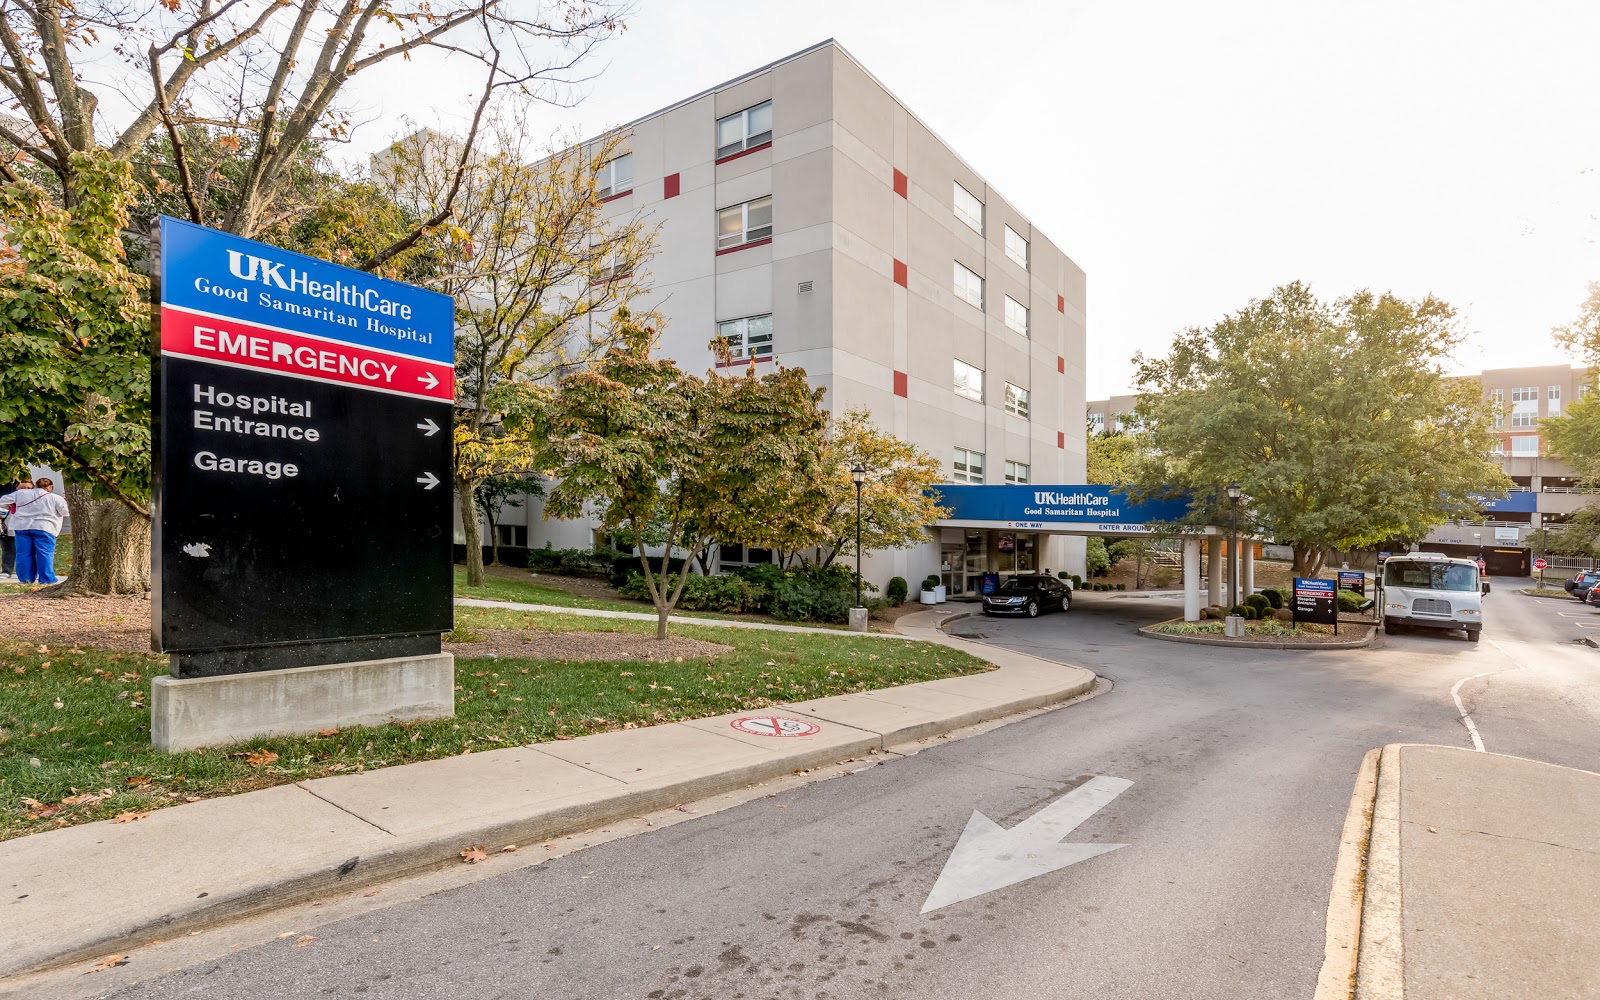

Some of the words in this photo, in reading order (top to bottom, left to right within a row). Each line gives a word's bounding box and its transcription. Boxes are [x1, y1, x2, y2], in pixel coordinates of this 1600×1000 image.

[195, 277, 249, 303] Good
[259, 292, 358, 328] Samaritan
[366, 317, 433, 345] Hospital
[193, 325, 398, 382] EMERGENCY
[193, 384, 312, 418] Hospital
[193, 410, 320, 442] Entrance
[194, 451, 299, 480] Garage
[1024, 507, 1042, 515] Good
[1045, 507, 1084, 516] Samaritan
[1087, 508, 1120, 517] Hospital
